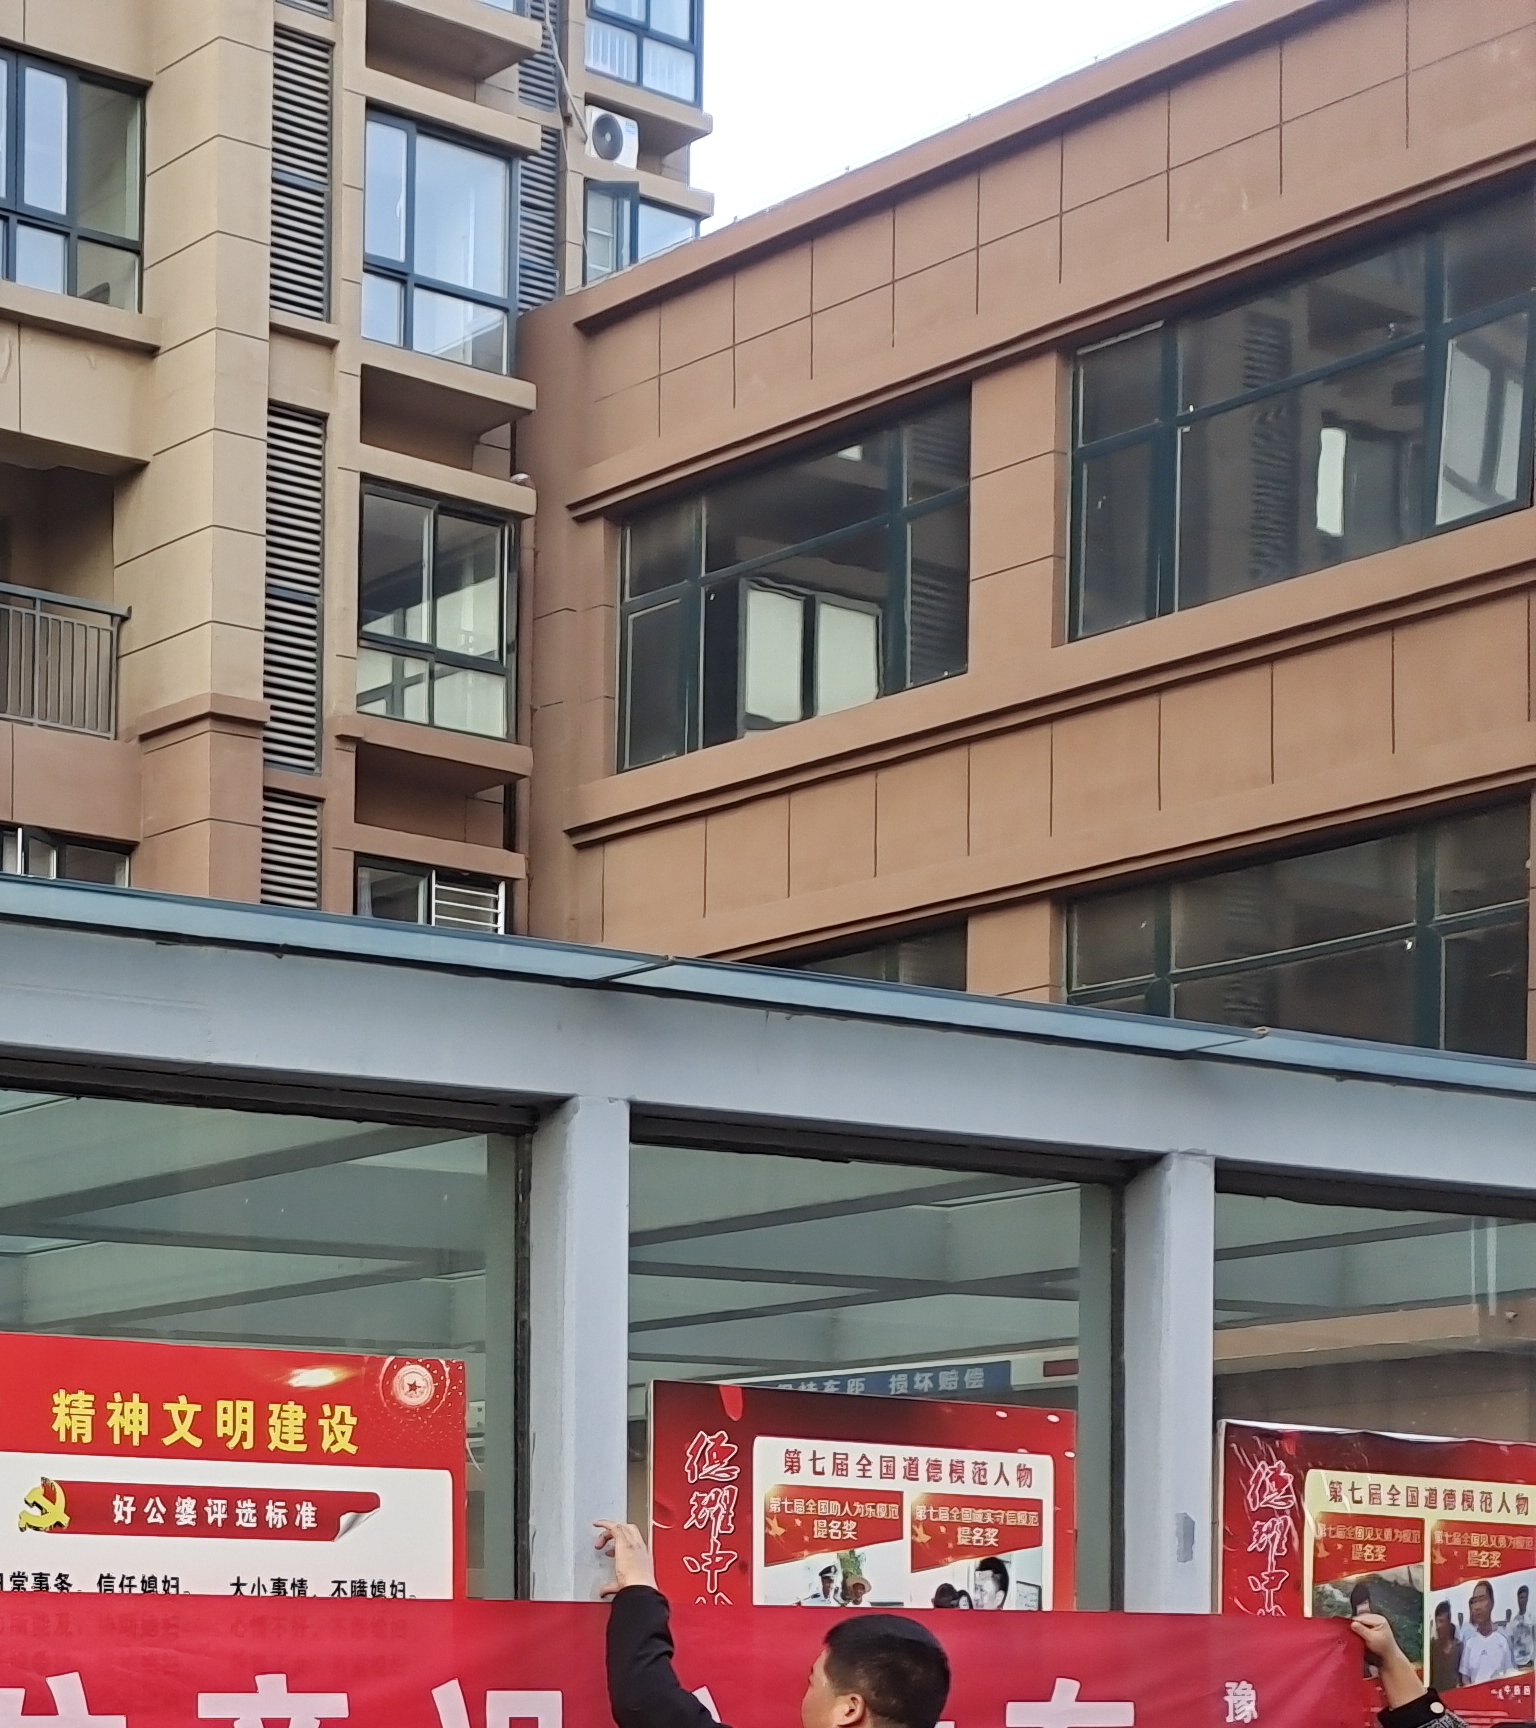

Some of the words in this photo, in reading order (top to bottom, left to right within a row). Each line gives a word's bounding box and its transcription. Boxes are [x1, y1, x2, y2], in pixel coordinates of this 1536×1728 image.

[888, 1368, 986, 1396] 损坏赔偿
[50, 1388, 361, 1455] 精神文明建设
[783, 1449, 1034, 1489] 第七届全国道德模范人物
[112, 1494, 319, 1531] 好公婆评选标准
[683, 1430, 740, 1606] 德耀中
[1328, 1480, 1530, 1517] 第七届全国道德模范人物
[1246, 1460, 1296, 1617] 德耀中
